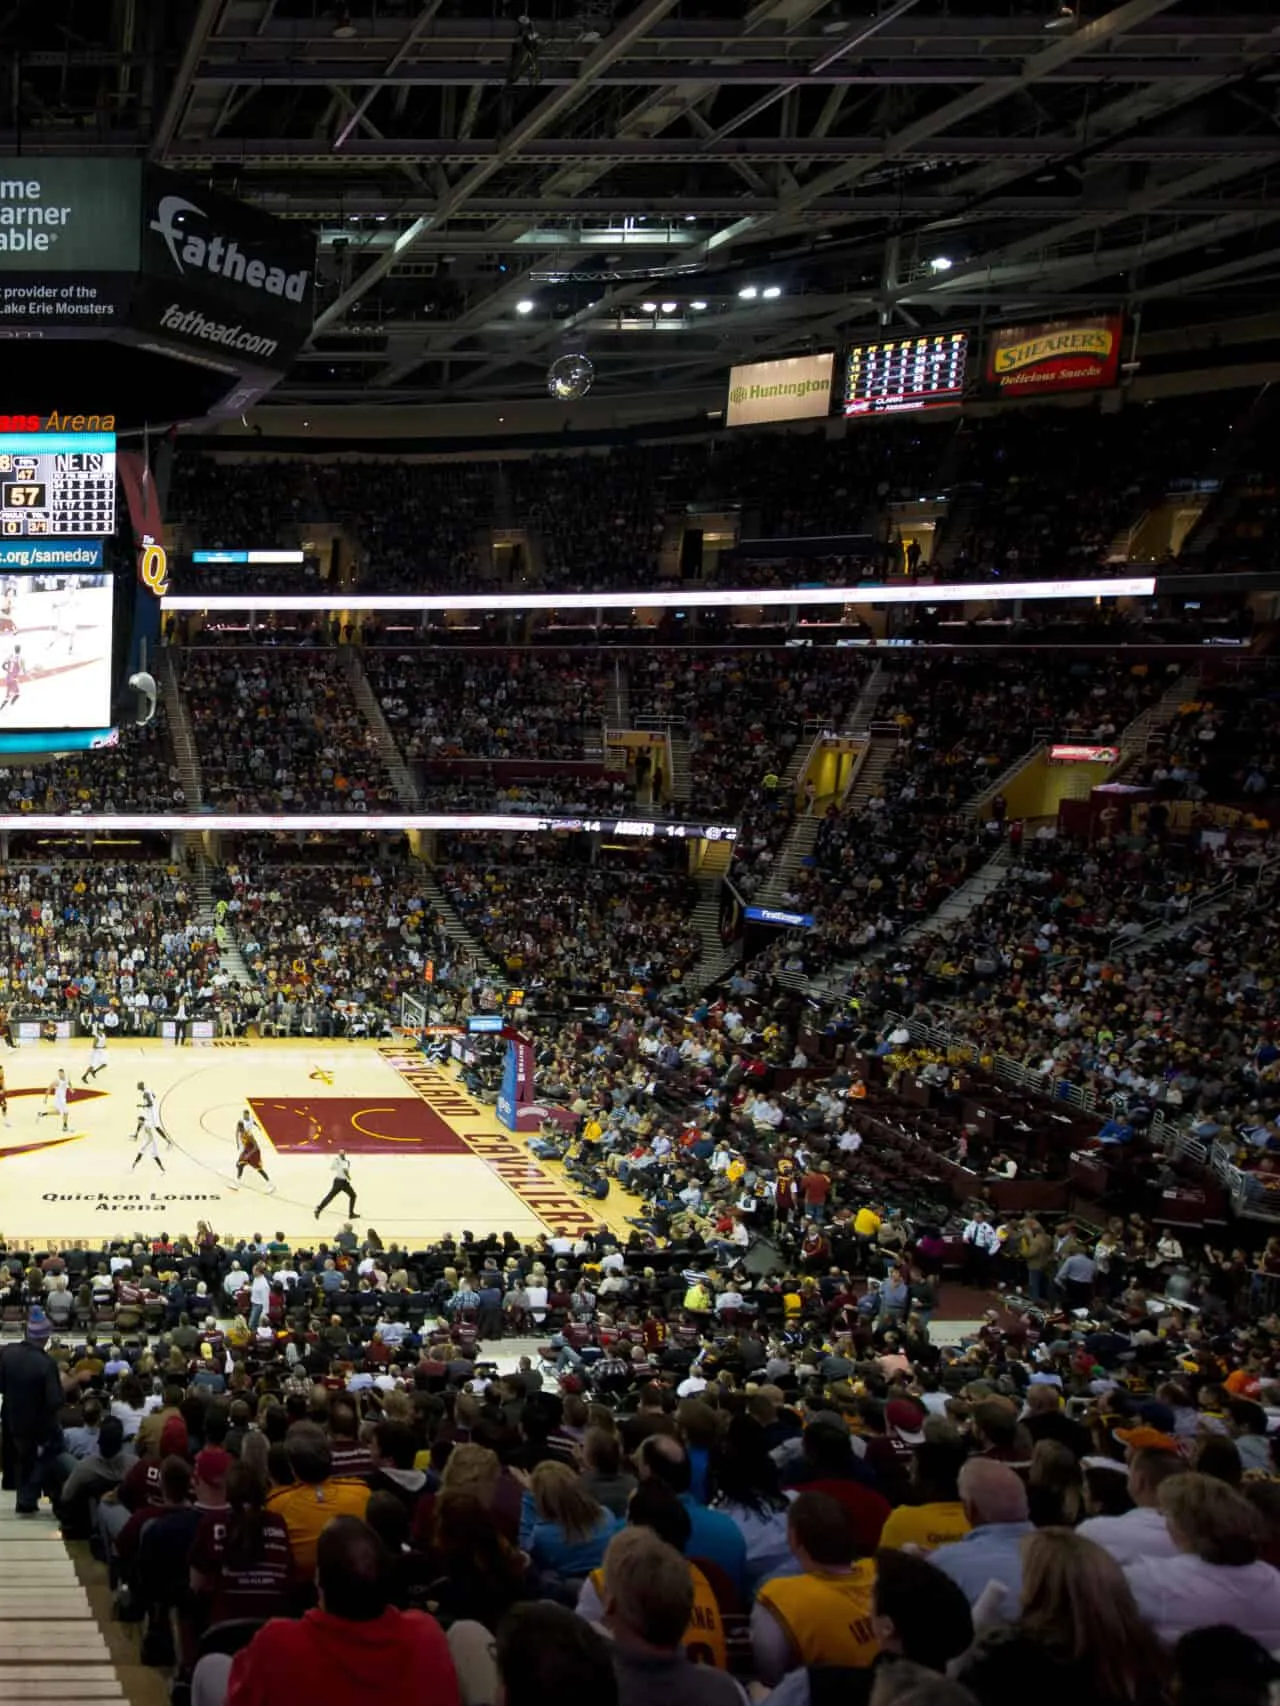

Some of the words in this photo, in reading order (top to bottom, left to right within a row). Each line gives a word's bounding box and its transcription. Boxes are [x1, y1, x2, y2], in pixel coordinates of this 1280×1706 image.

[4, 286, 57, 301] provider
[60, 285, 74, 298] of
[76, 286, 97, 298] the
[28, 302, 53, 314] Erie
[55, 302, 115, 314] Monsters
[160, 303, 279, 357] fathead.com
[1000, 372, 1055, 386] Delicious
[1060, 366, 1102, 379] Snacks
[749, 379, 831, 397] Huntington
[45, 410, 115, 432] Arena
[55, 453, 102, 472] NETS
[18, 469, 34, 480] 47
[11, 487, 39, 506] 57
[7, 523, 17, 534] 0
[141, 543, 169, 595] Q
[583, 821, 602, 832] 14
[665, 825, 686, 837] 14
[378, 1046, 481, 1117] CLEVELAND
[463, 1133, 602, 1239] CAVALIERS
[41, 1192, 142, 1203] Quicken
[150, 1192, 222, 1201] Loans
[95, 1202, 167, 1212] Arena
